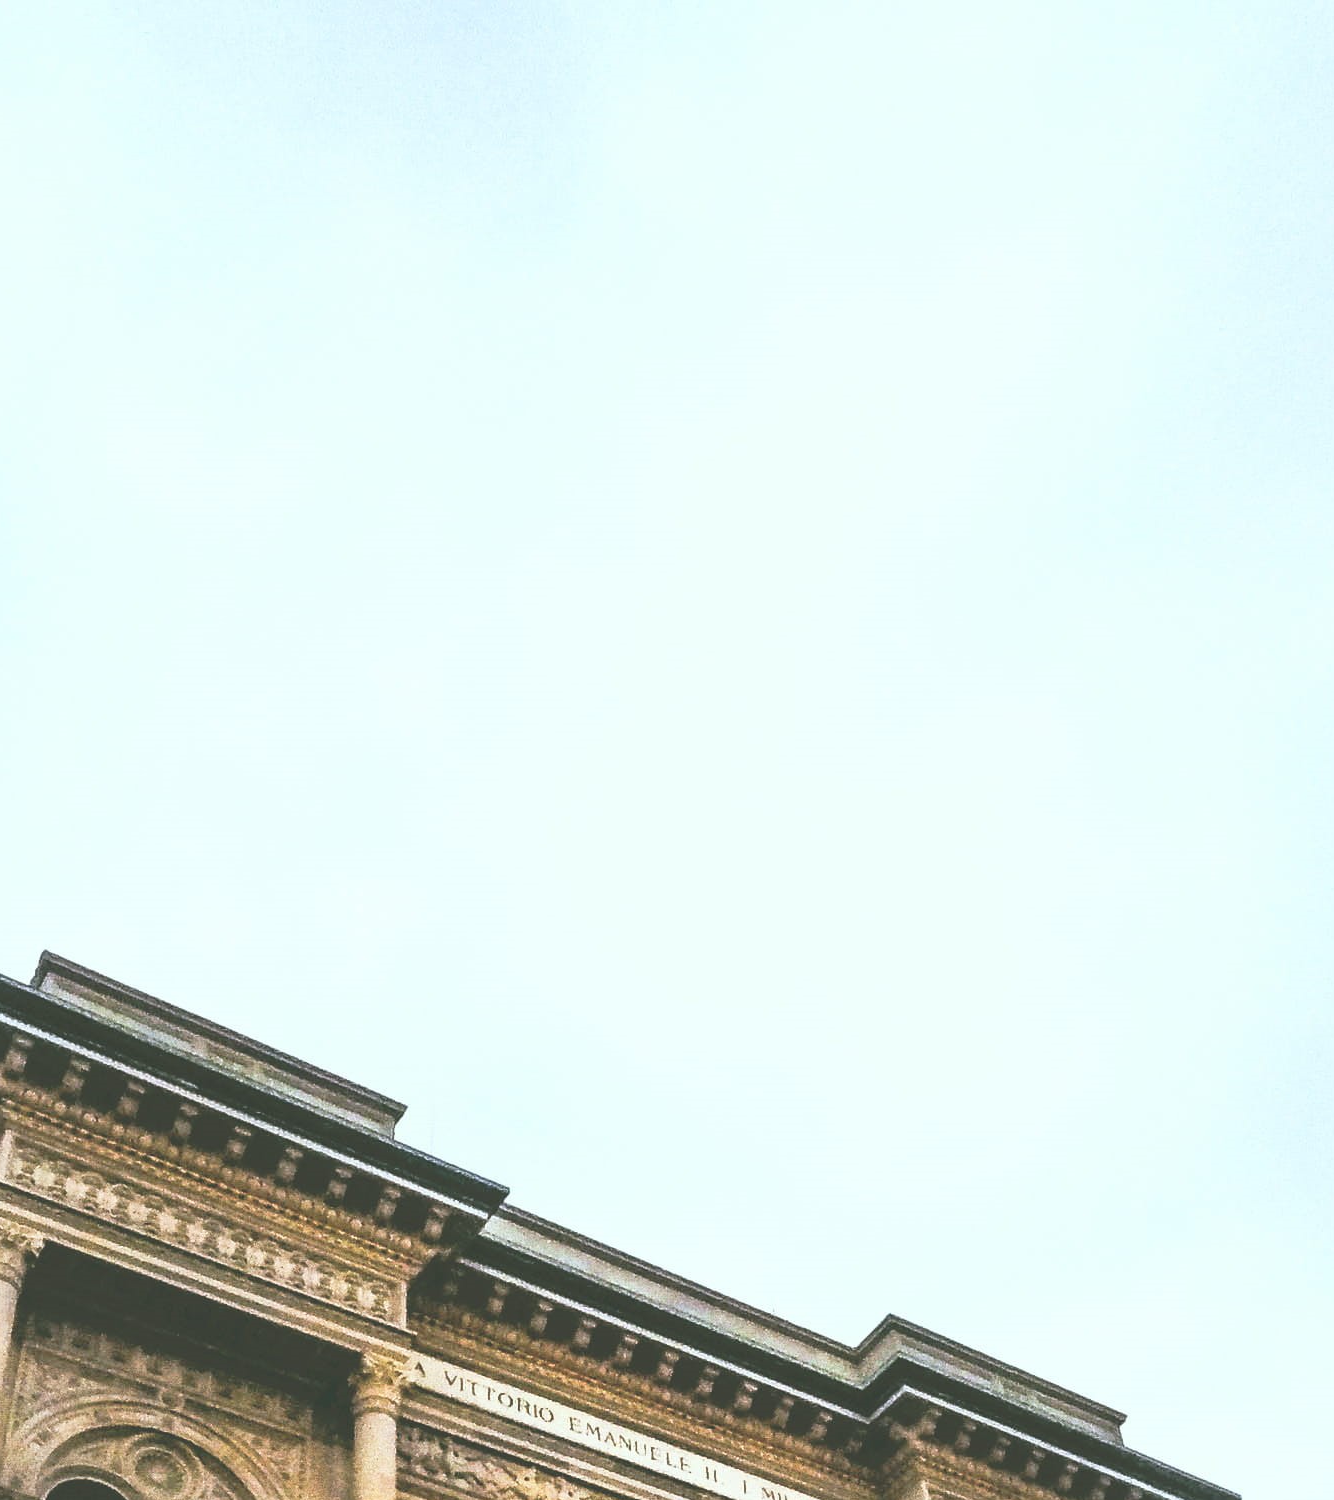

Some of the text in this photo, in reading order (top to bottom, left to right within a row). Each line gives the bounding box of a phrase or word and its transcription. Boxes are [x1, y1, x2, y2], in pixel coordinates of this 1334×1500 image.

[414, 1361, 427, 1378] A
[444, 1370, 555, 1423] VITTORIO
[568, 1416, 692, 1474] EMANUELE
